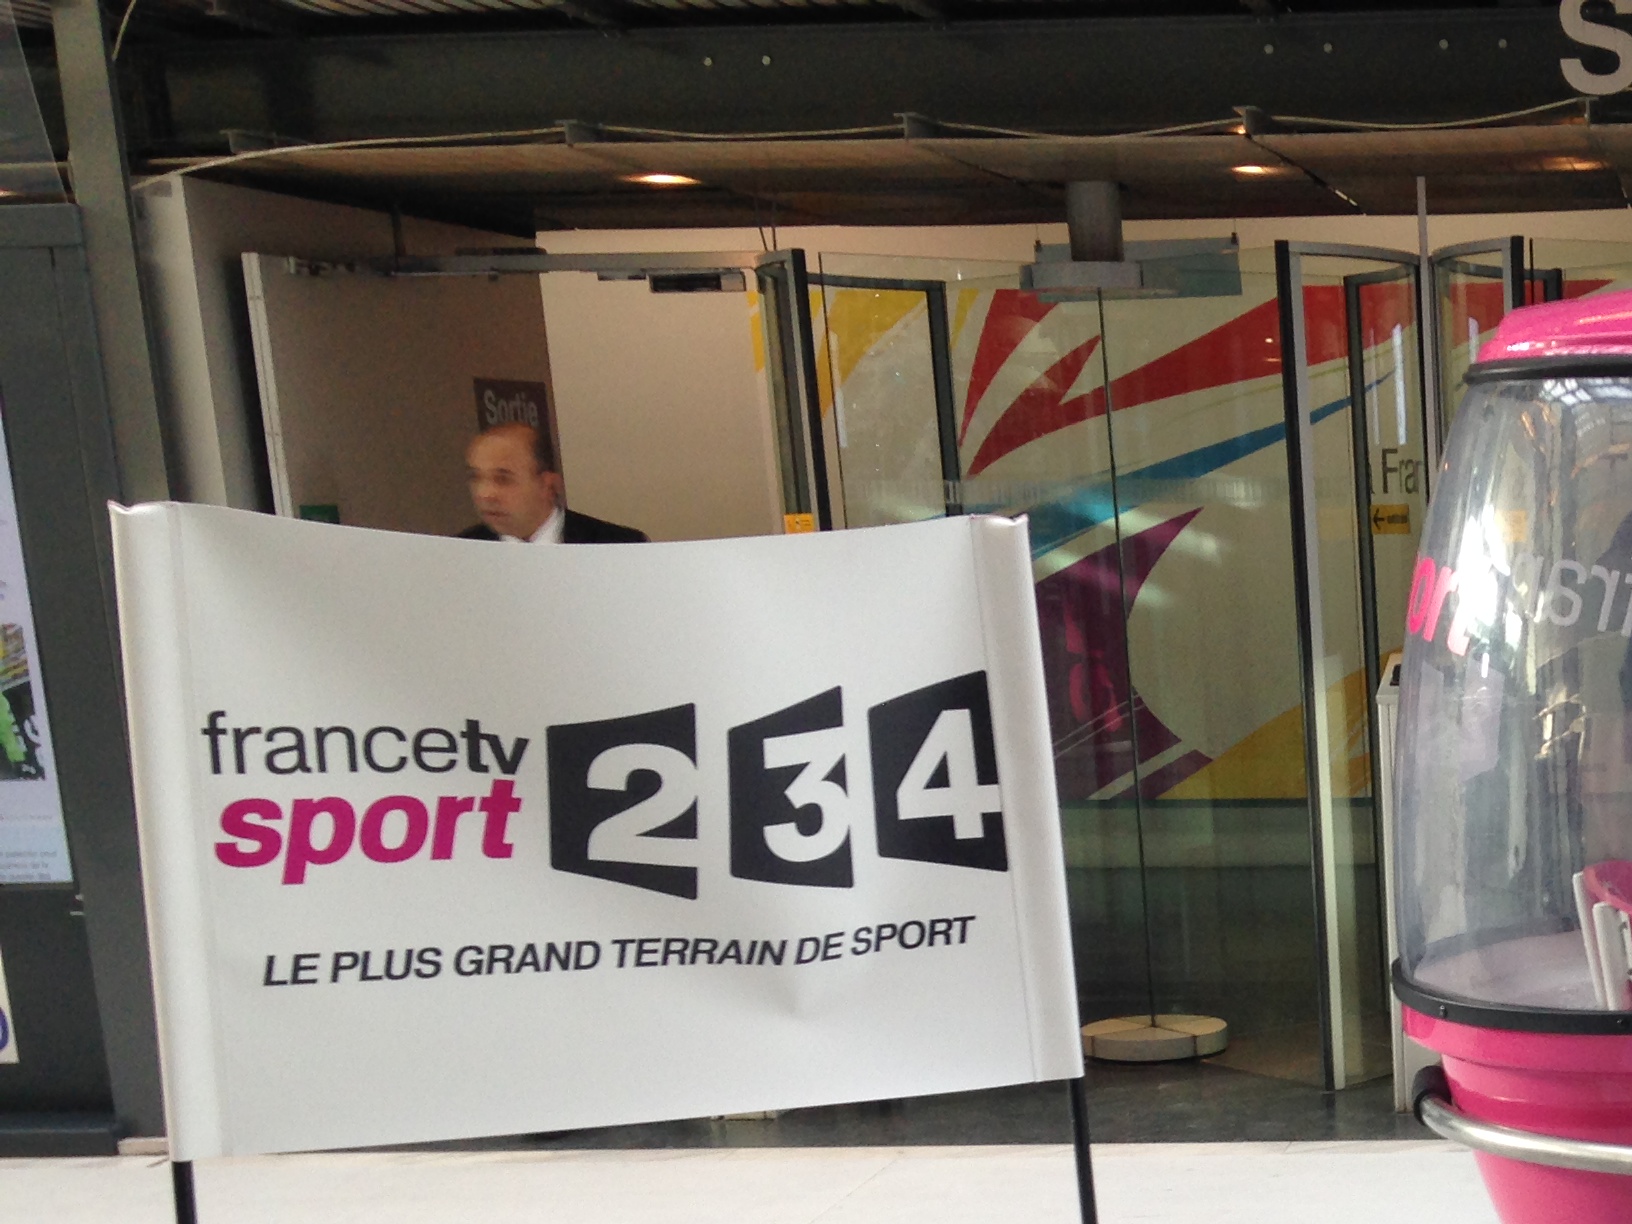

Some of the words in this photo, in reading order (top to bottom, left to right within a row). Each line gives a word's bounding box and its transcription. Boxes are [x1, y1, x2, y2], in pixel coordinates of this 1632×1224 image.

[483, 389, 540, 427] Sortie
[201, 709, 529, 776] francetv
[896, 708, 1003, 840] 4
[213, 778, 522, 885] sport
[263, 952, 321, 986] LE
[329, 947, 443, 983] PLUS
[453, 940, 601, 977] GRAND
[611, 937, 788, 968] TERRAIN
[794, 931, 845, 965] DE
[851, 915, 976, 956] SPORT
